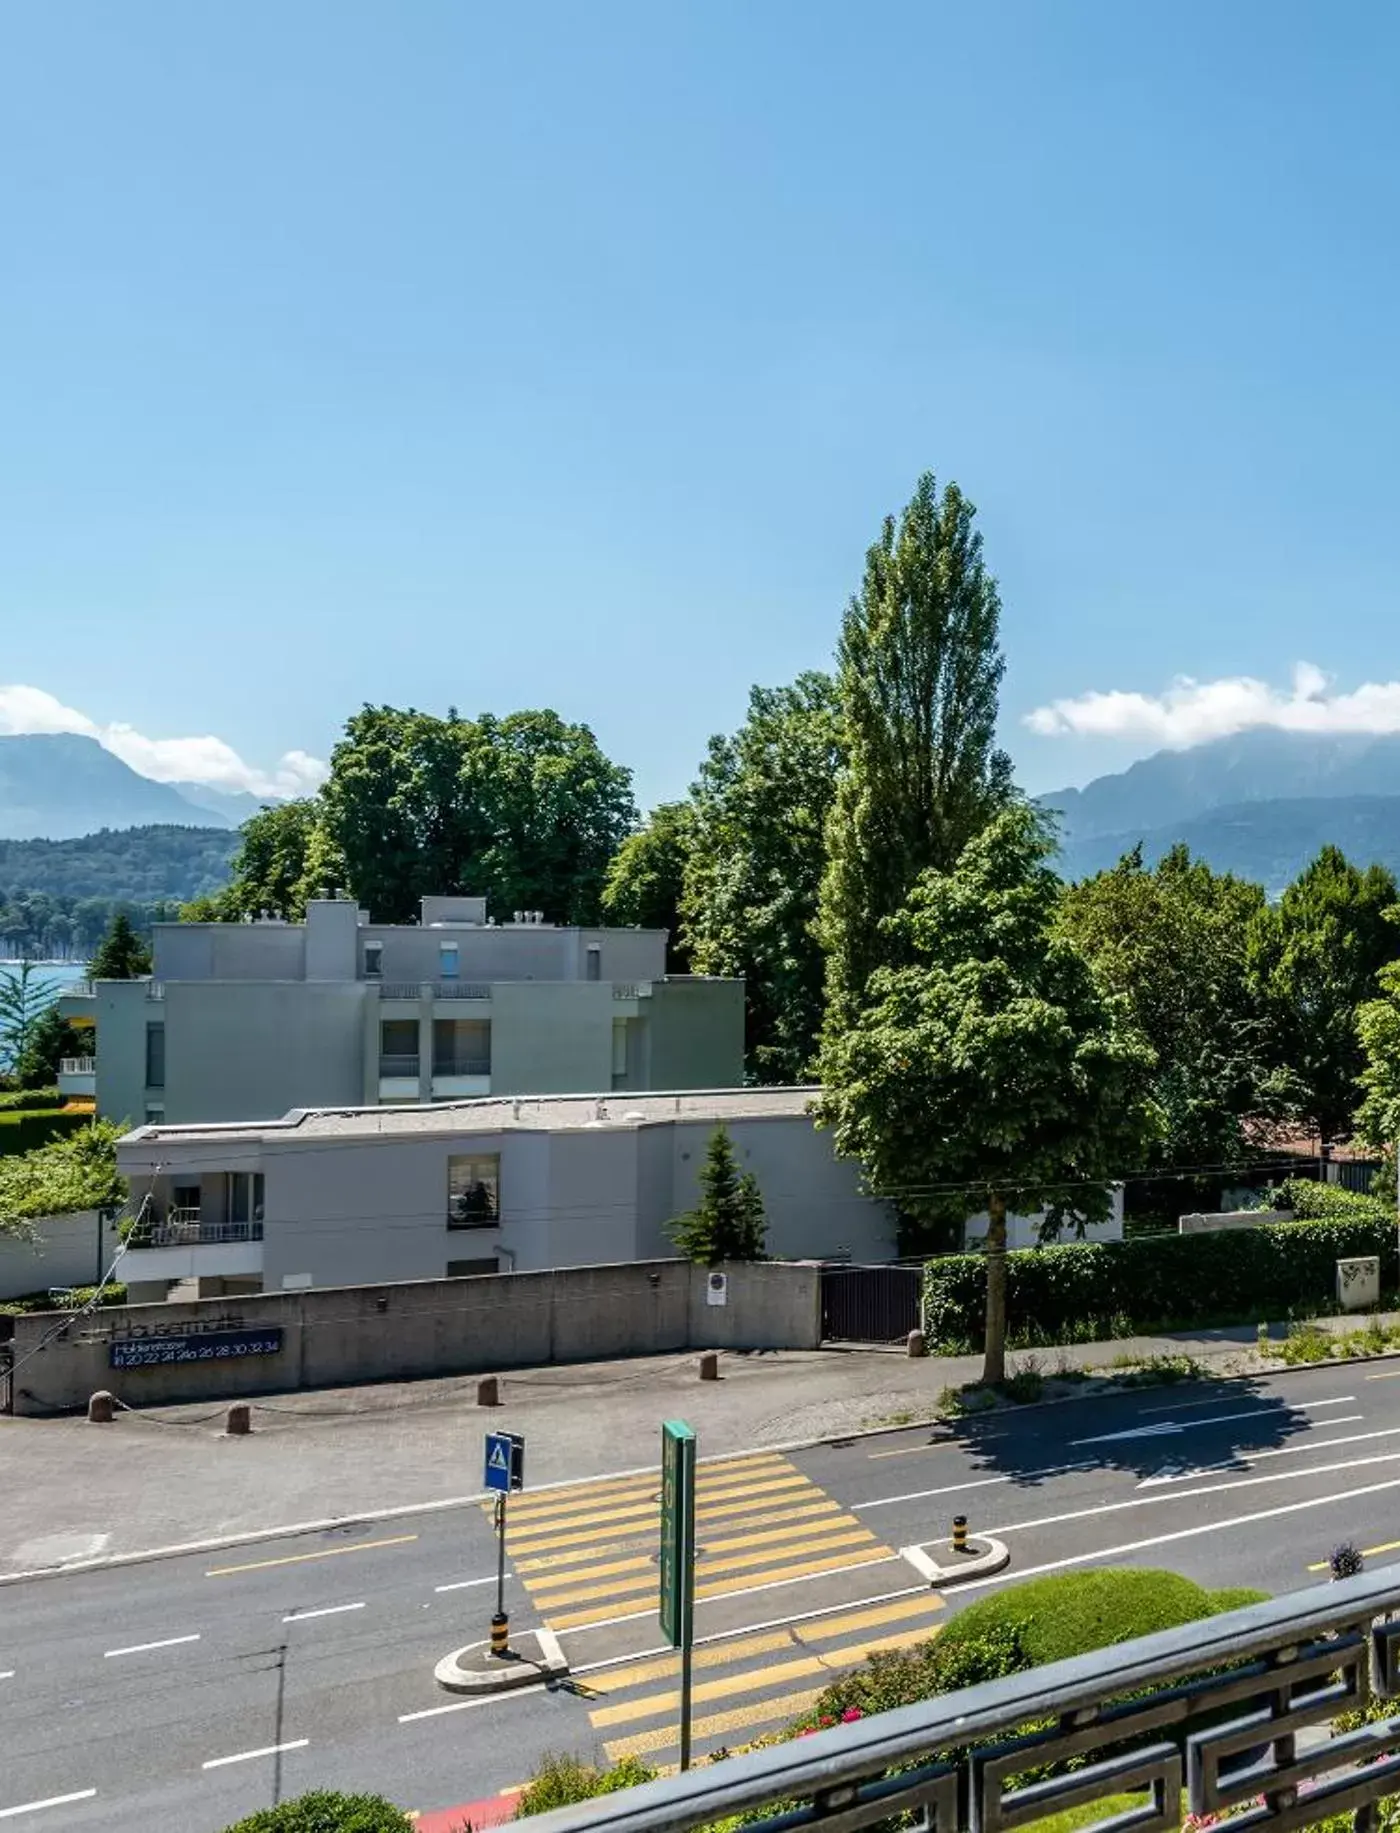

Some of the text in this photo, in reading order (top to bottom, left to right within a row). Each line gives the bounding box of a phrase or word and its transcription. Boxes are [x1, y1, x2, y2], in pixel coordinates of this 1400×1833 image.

[126, 1351, 143, 1366] 20
[143, 1351, 160, 1364] 22
[215, 1345, 230, 1357] 28
[231, 1343, 247, 1356] 30
[664, 1436, 676, 1630] HOTEL
